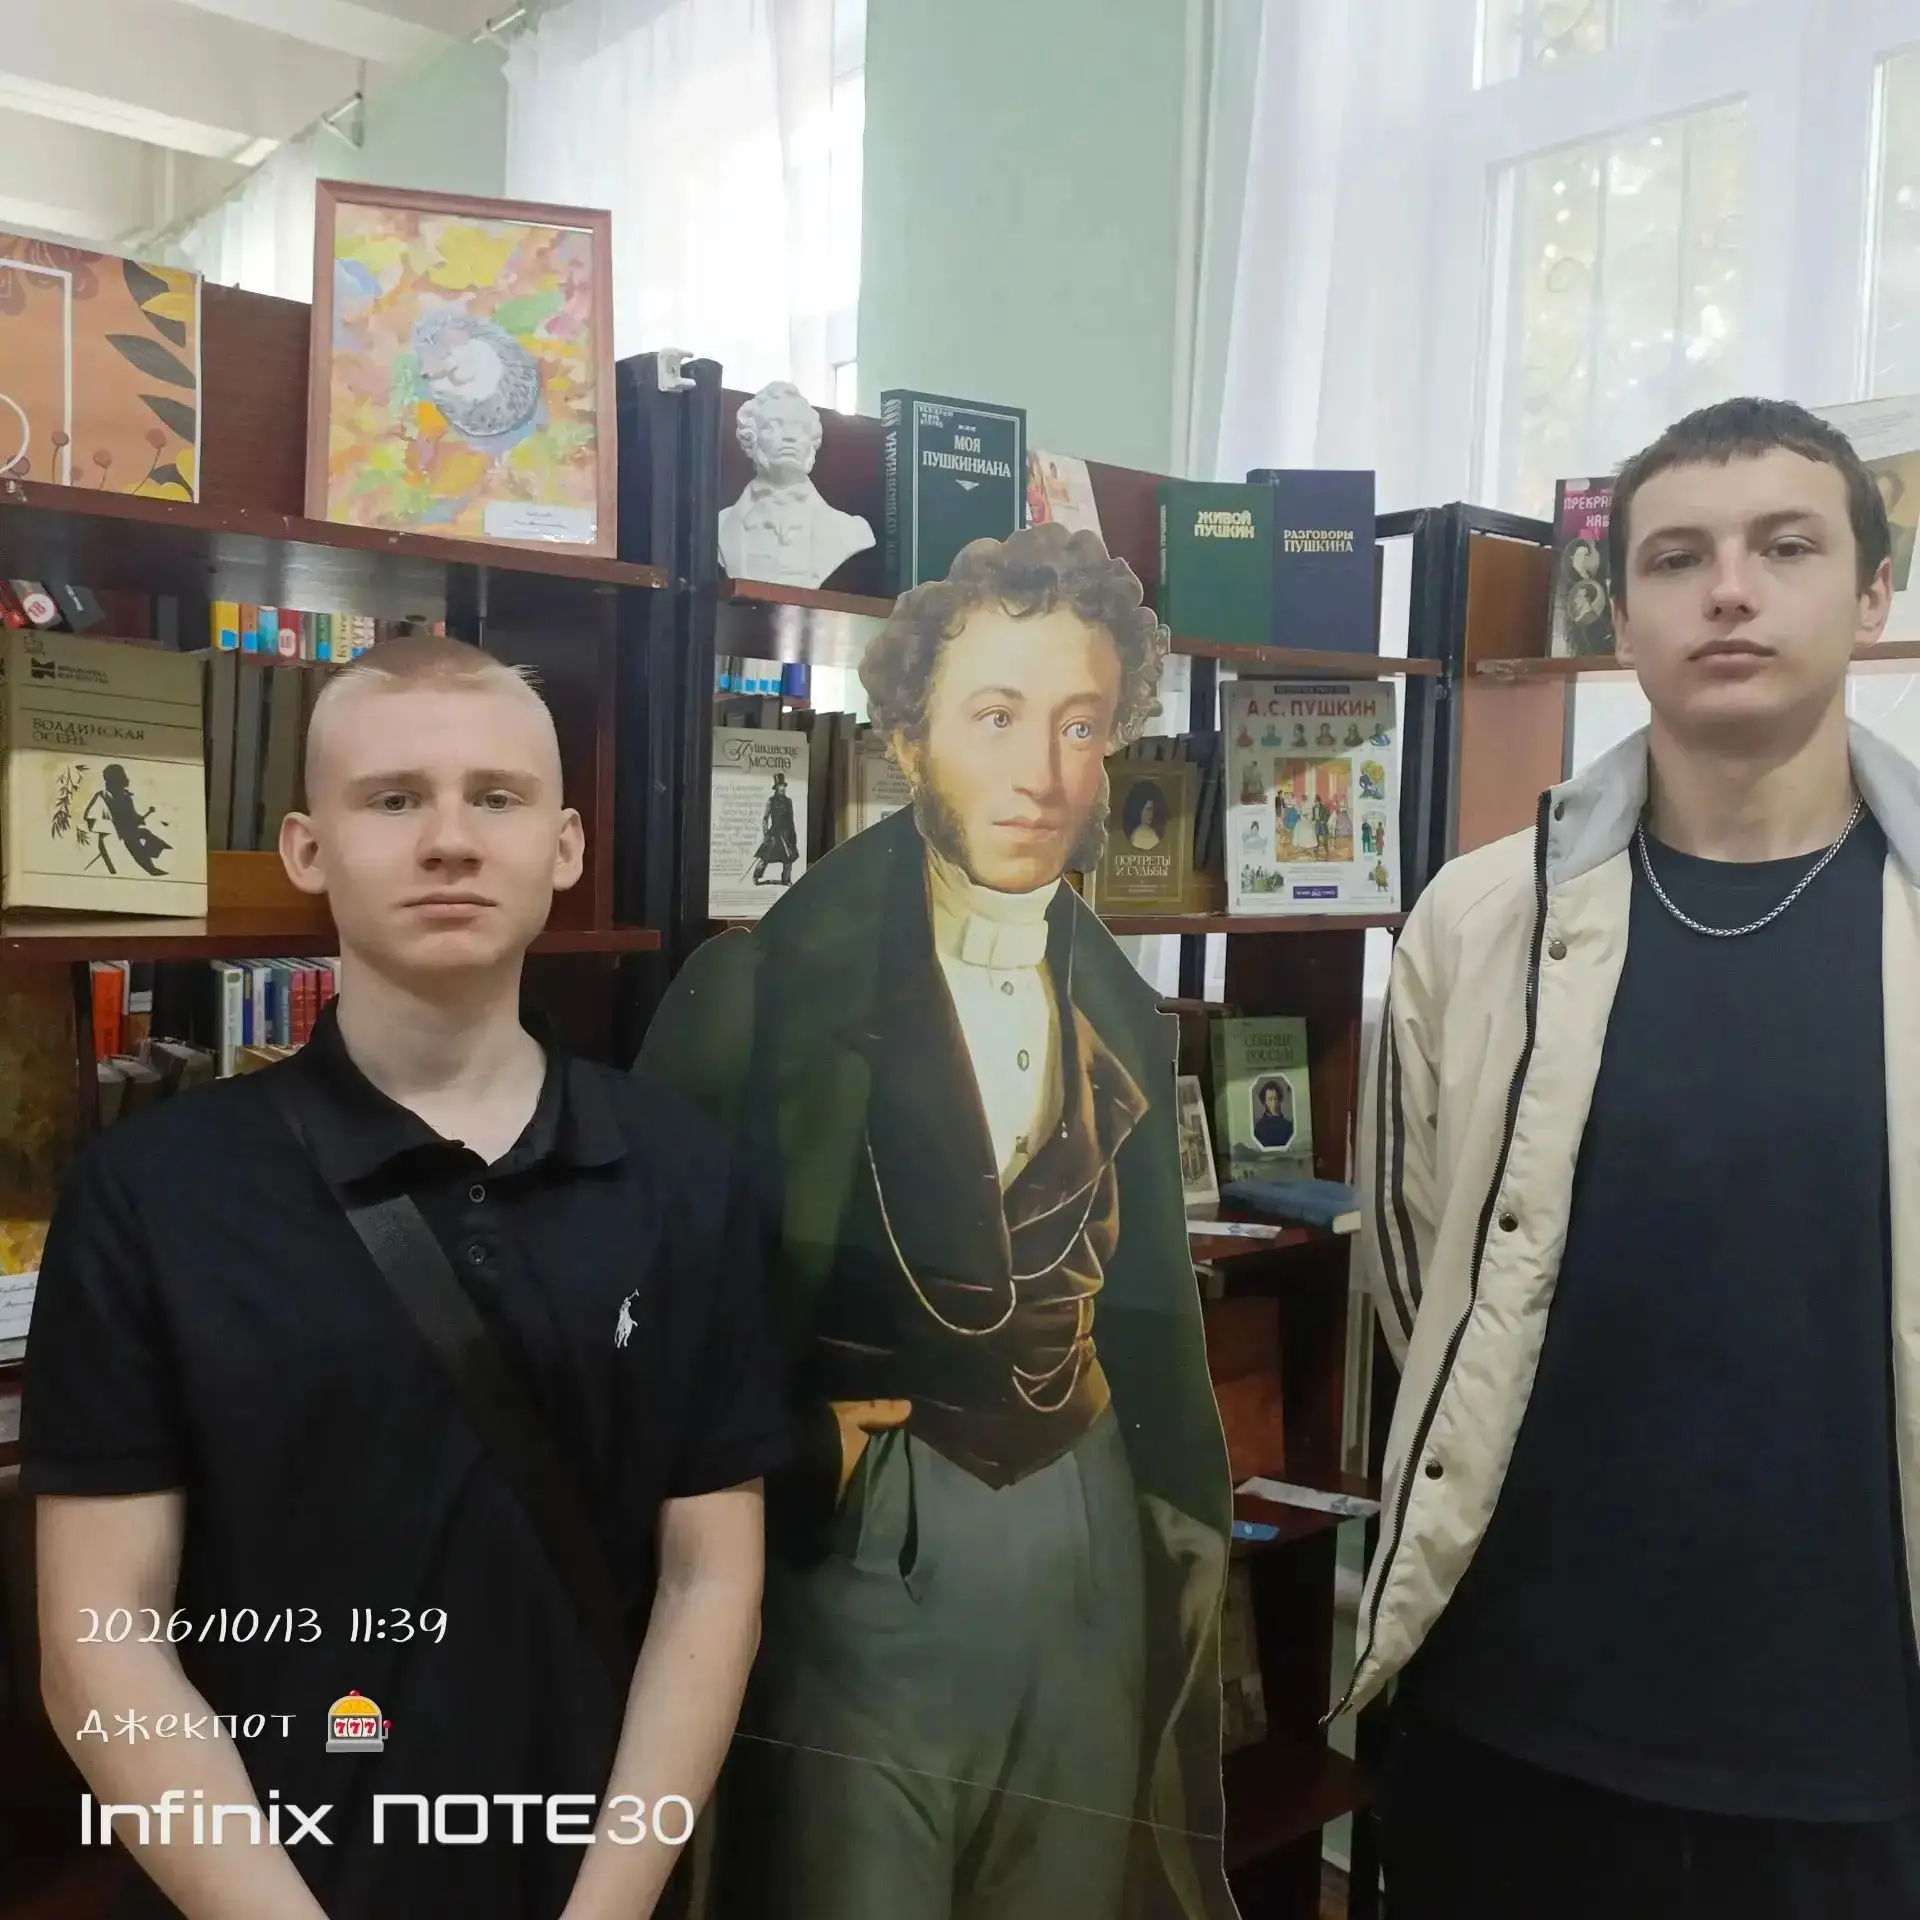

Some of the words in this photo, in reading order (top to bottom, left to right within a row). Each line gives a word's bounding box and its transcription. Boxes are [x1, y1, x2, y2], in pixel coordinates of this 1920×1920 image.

[954, 434, 981, 453] МОЯ
[922, 451, 1012, 478] ПУШКИНИАНА
[1197, 510, 1252, 525] ЖИВОЙ
[1194, 524, 1255, 539] ПУШКИН
[1284, 529, 1354, 540] РАЗГОВОРЫ
[1284, 539, 1354, 553] ПУШКИНА
[1290, 700, 1376, 717] ПУШКИН
[32, 717, 145, 741] БОЛДИНСКАЯ
[33, 730, 88, 746] ОСЕНЬ
[1115, 855, 1171, 866] ПОРТРЕТЫ
[1116, 866, 1124, 877] И
[1127, 865, 1169, 877] СУДЬБЫ
